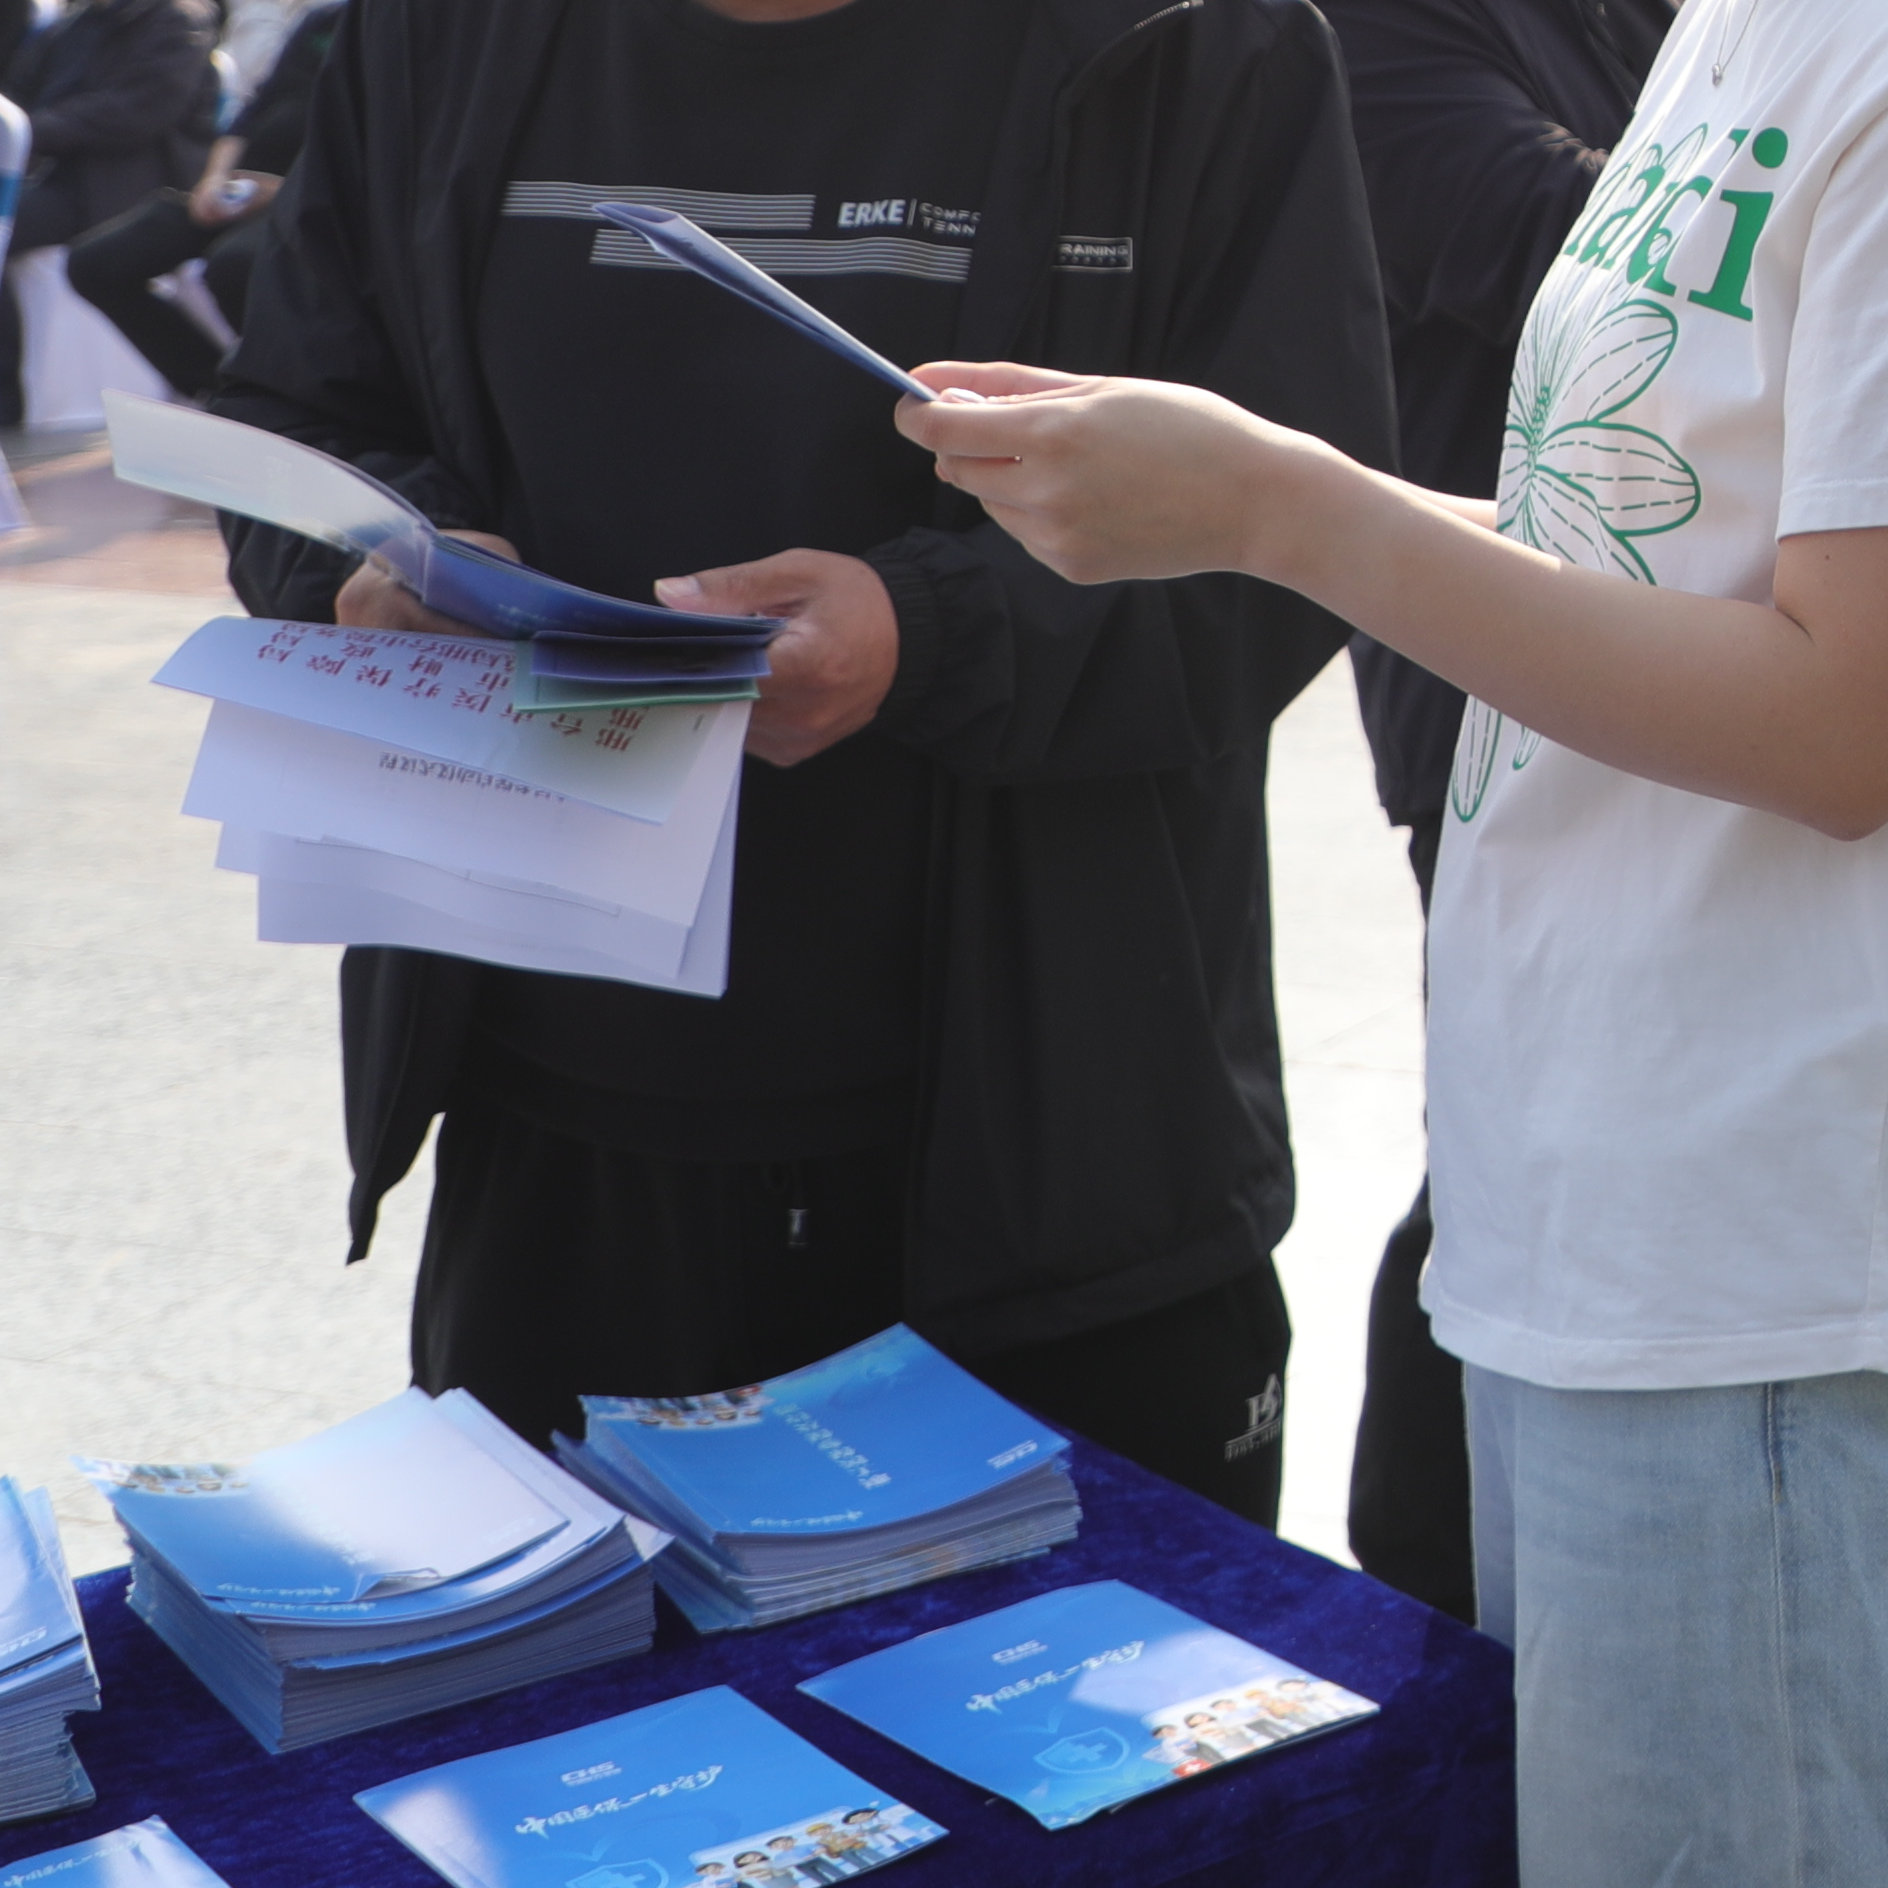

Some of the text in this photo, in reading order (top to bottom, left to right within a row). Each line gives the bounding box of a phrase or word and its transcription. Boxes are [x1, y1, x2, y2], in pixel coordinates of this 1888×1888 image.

[838, 199, 907, 228] ERKE
[270, 630, 648, 730] 邢市财政局
[513, 1766, 723, 1838] 中国医保一生守护
